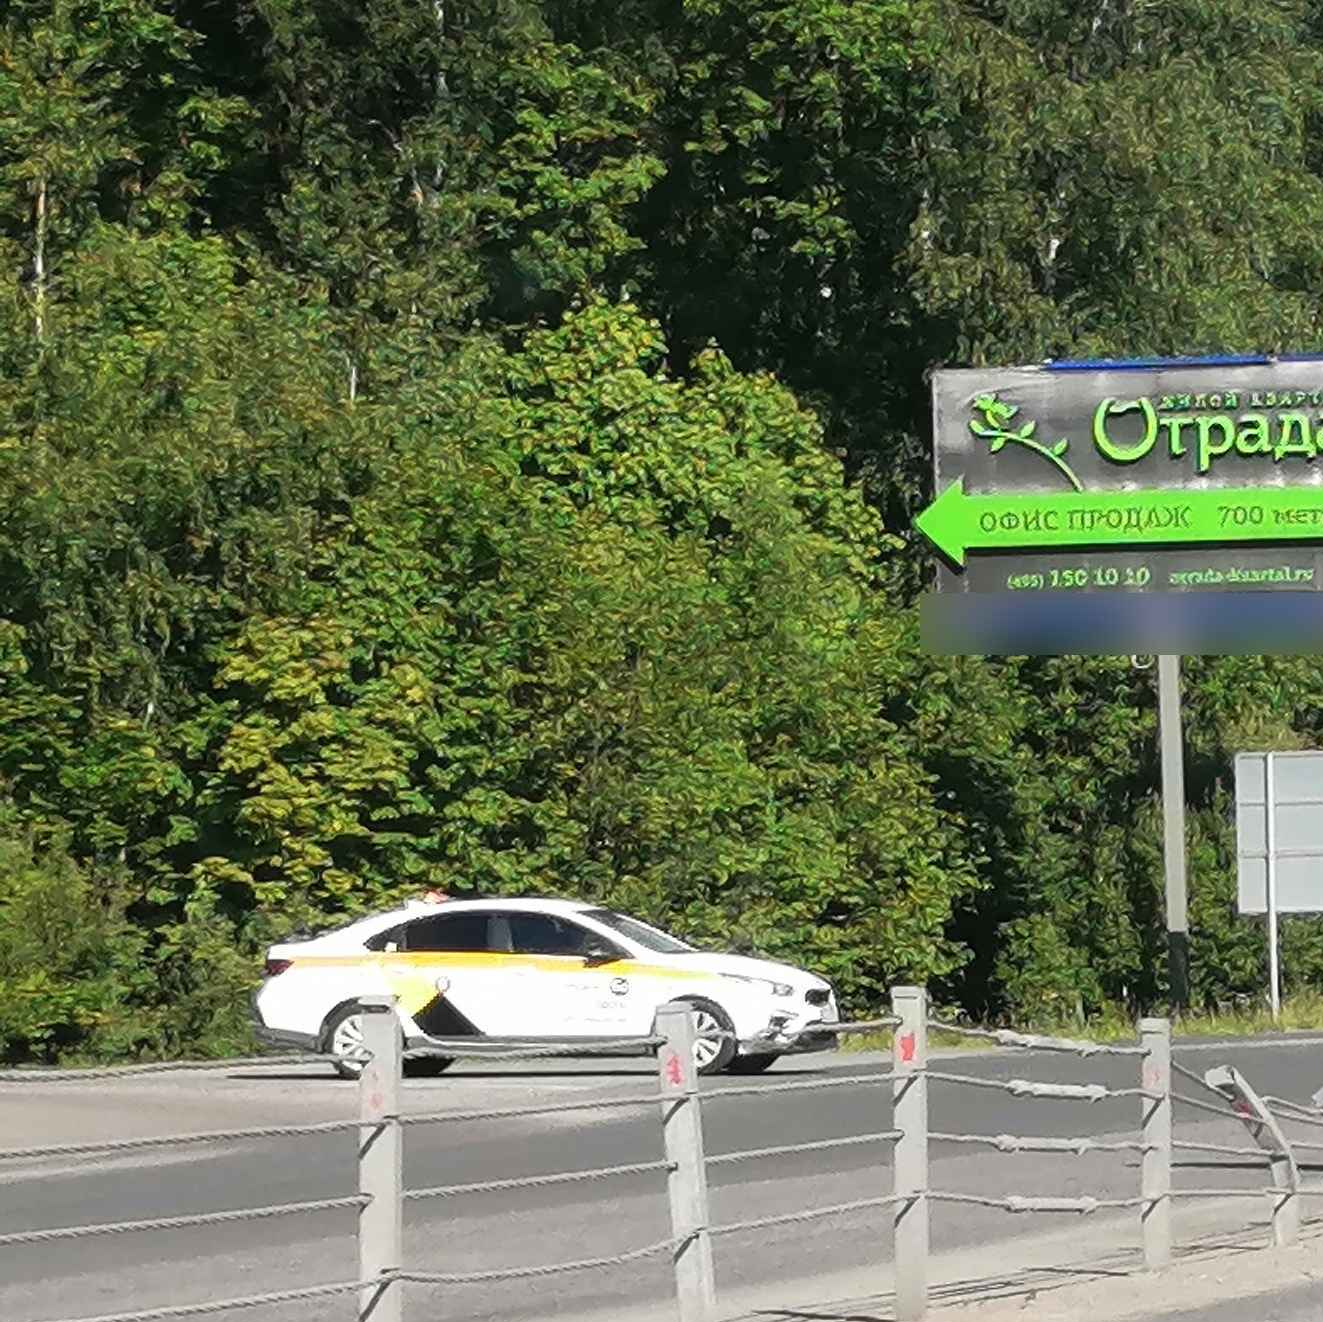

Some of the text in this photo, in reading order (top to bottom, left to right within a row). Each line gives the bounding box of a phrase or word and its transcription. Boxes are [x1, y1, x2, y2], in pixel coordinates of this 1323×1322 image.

[979, 509, 1059, 533] ОФИС
[1066, 504, 1193, 533] ПРОДАЖ
[1217, 505, 1264, 526] 700
